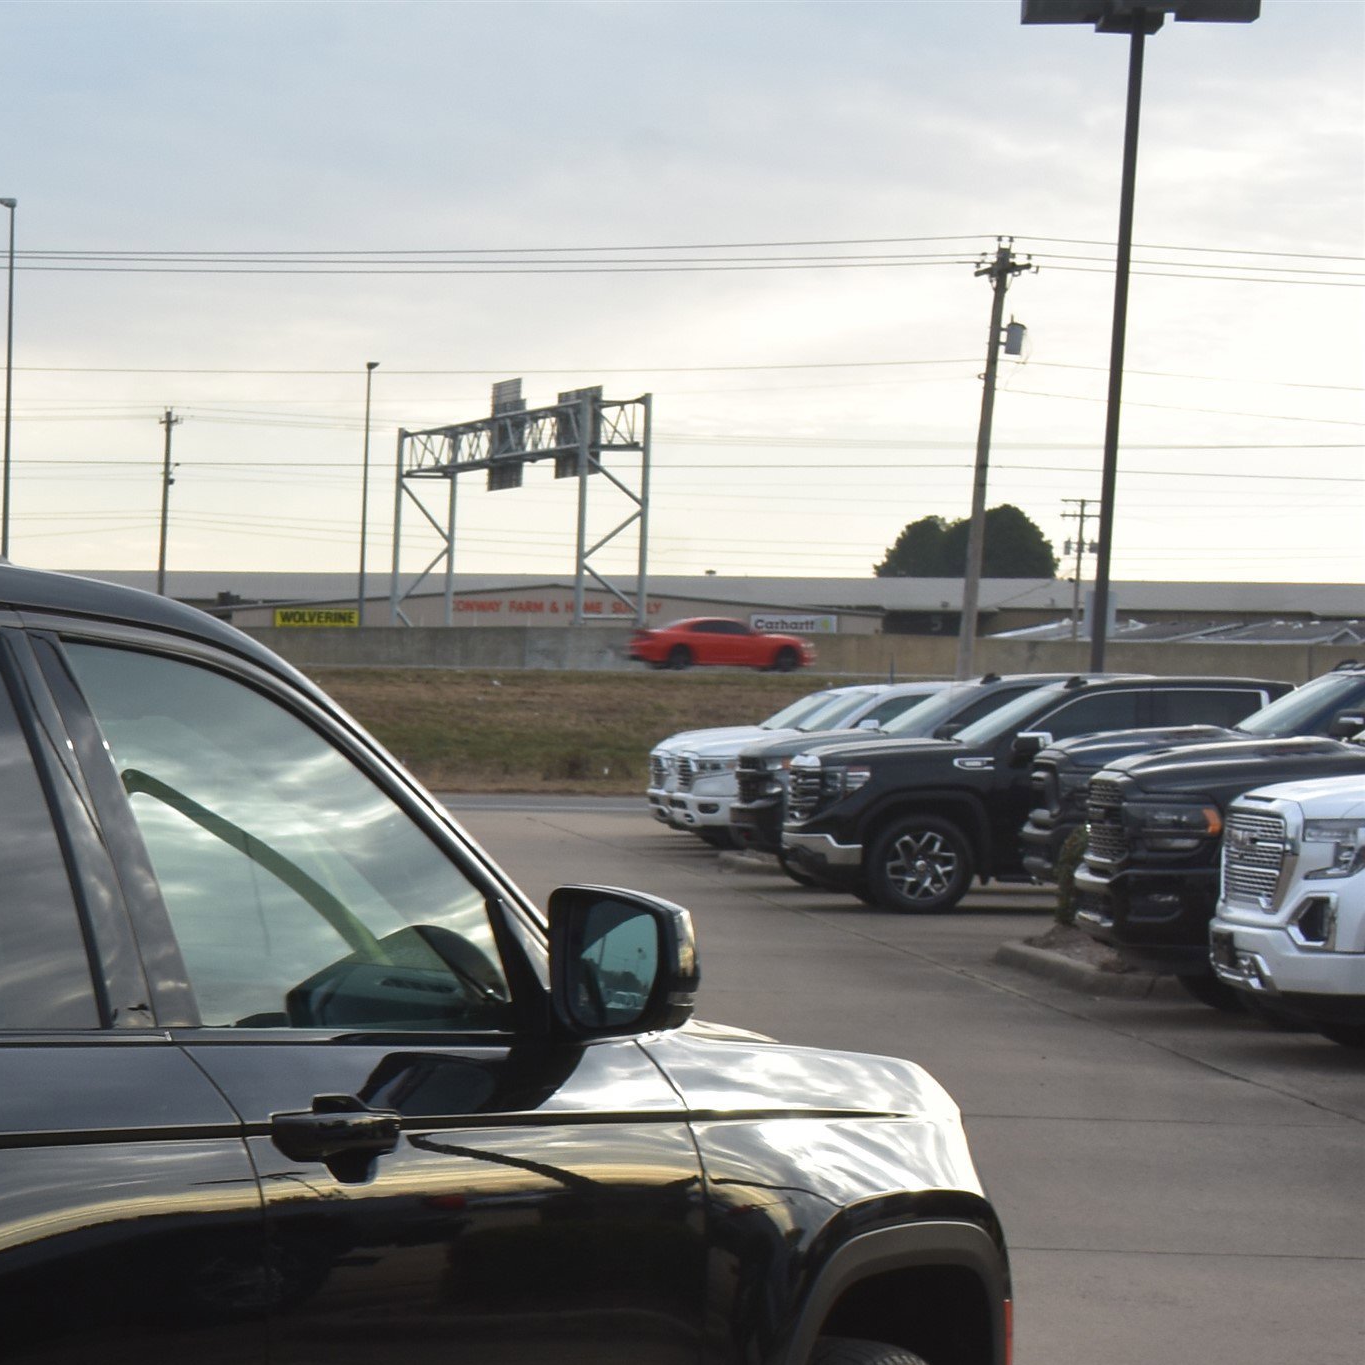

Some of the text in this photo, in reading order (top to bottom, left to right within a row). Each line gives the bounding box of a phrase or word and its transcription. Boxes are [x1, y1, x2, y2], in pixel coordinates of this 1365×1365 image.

[508, 600, 545, 613] FARM
[550, 600, 559, 613] &
[565, 602, 602, 613] HME
[612, 602, 662, 614] SULY
[279, 611, 356, 624] WOLVERINE
[754, 618, 815, 630] Carhartt
